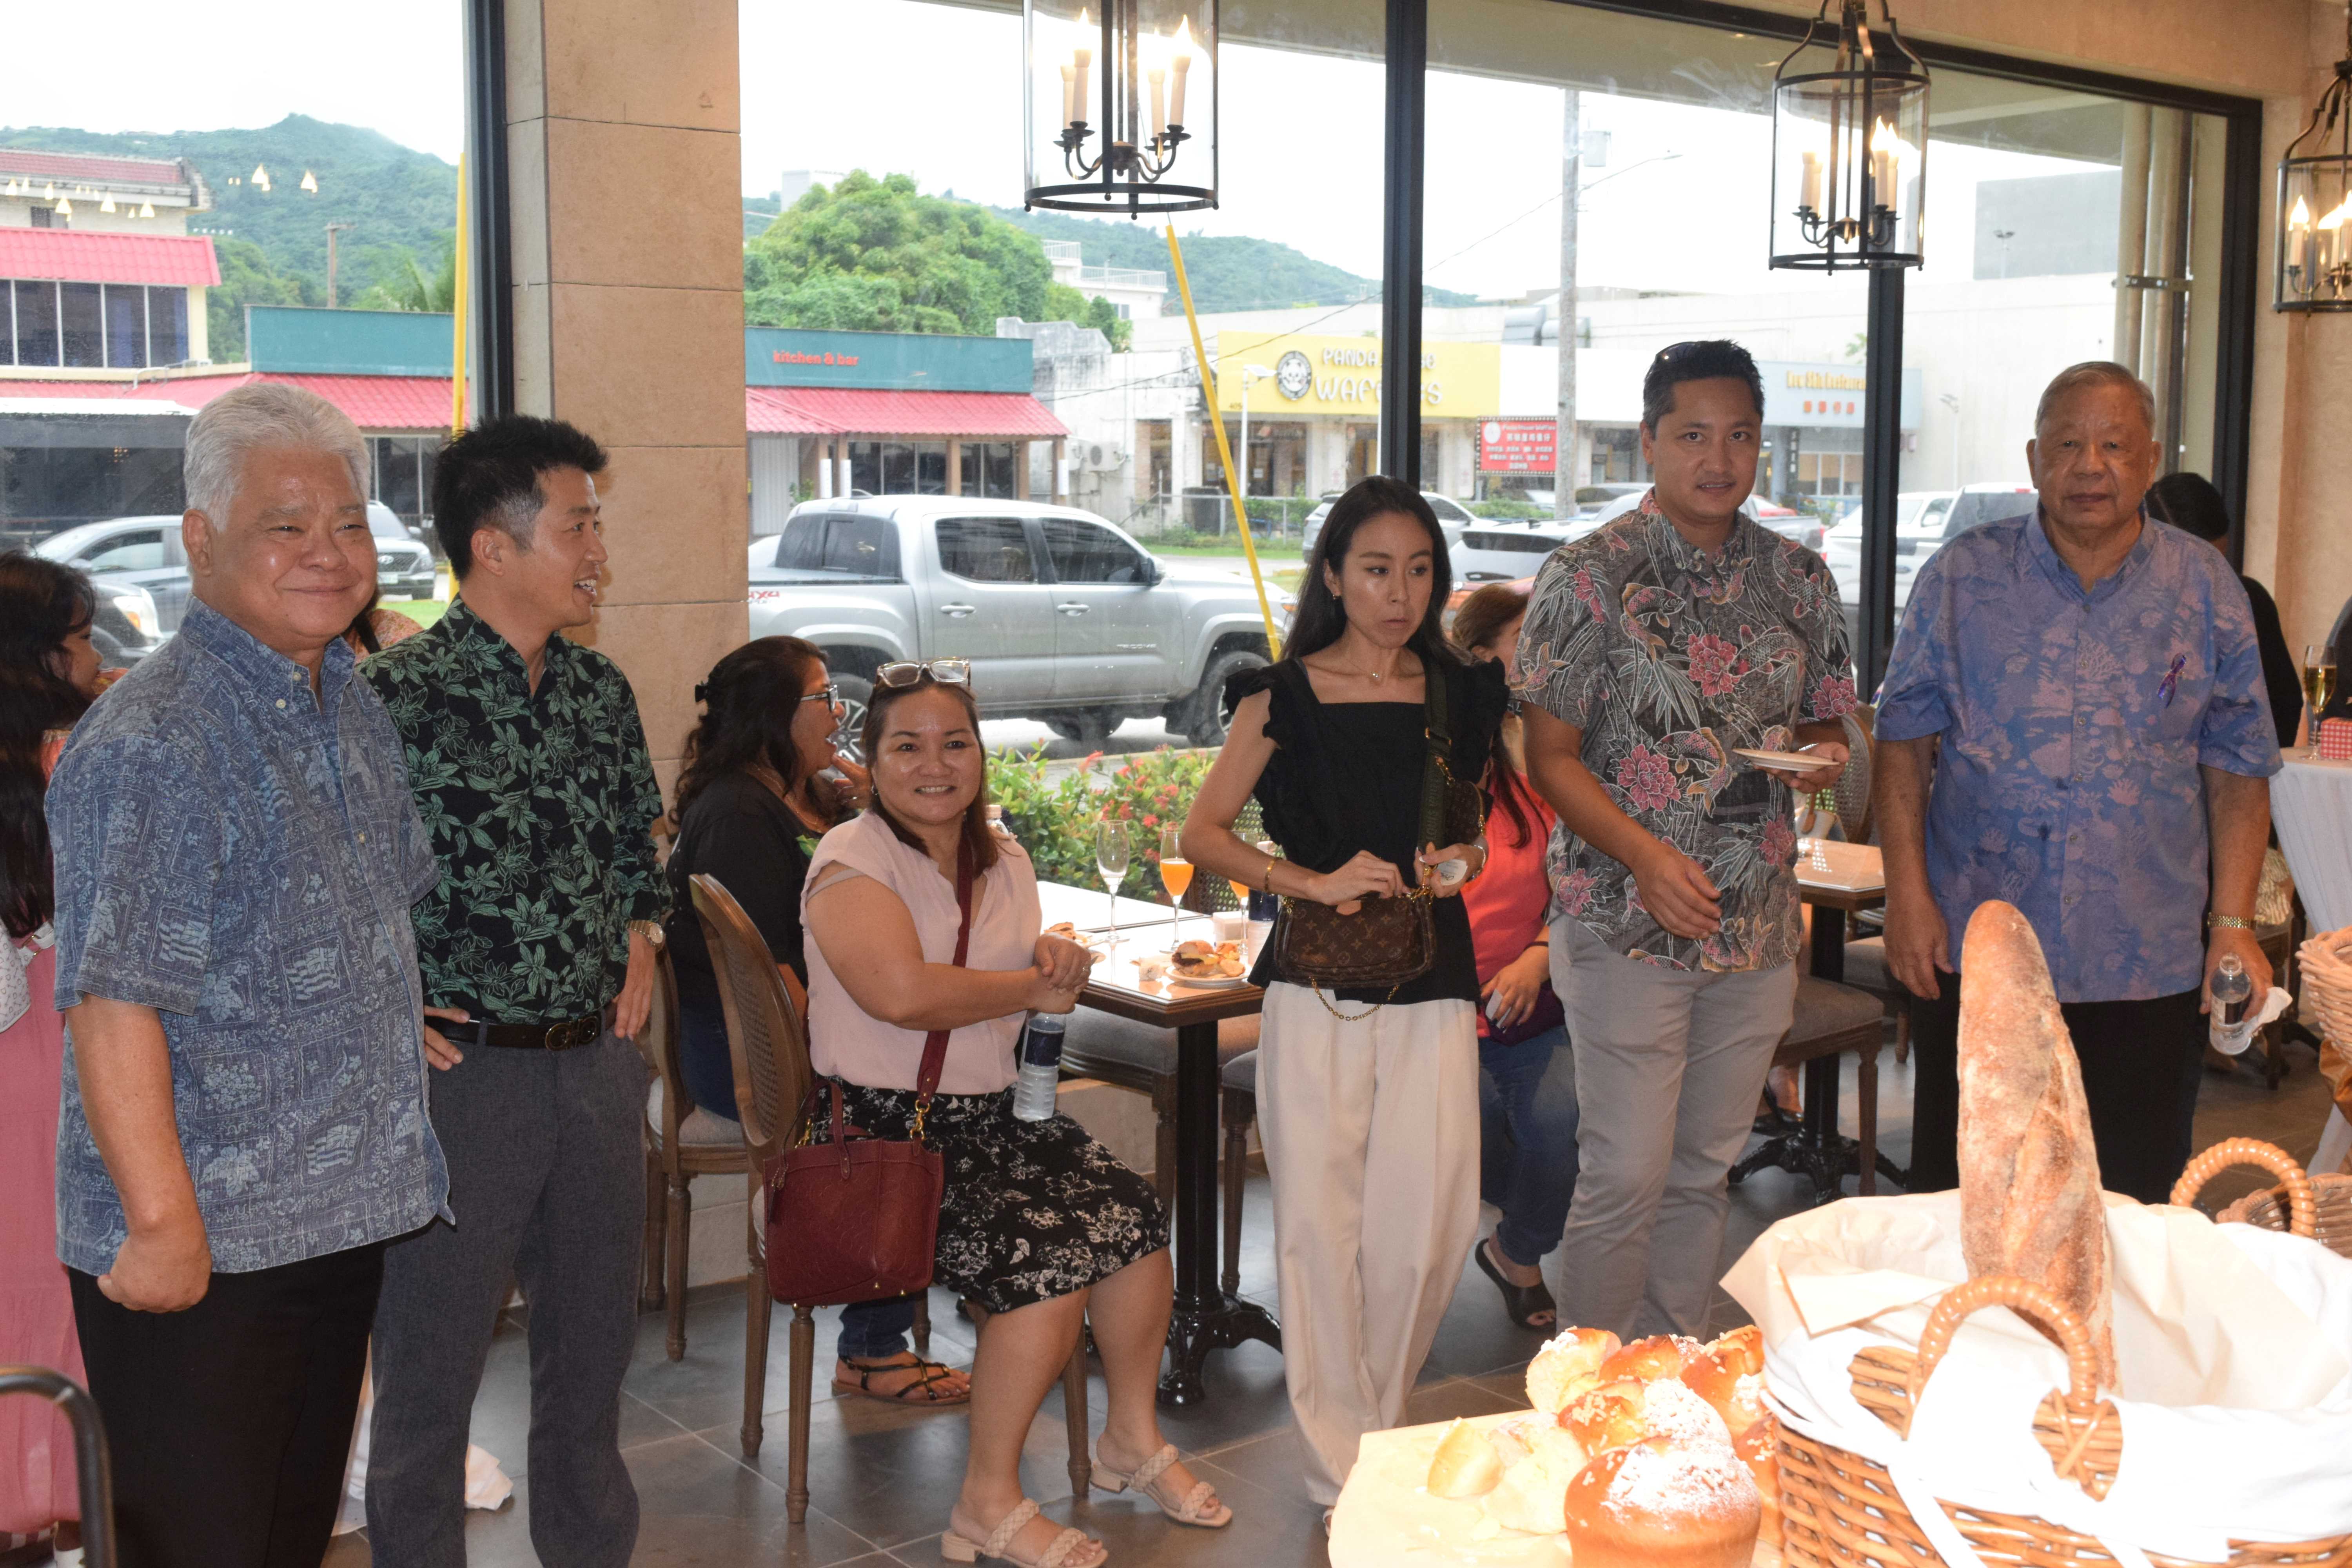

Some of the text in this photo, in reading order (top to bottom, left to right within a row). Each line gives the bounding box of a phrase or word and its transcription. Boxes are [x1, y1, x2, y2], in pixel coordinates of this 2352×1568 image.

[773, 350, 859, 366] kitchen & bar
[1323, 347, 1378, 367] PANDA
